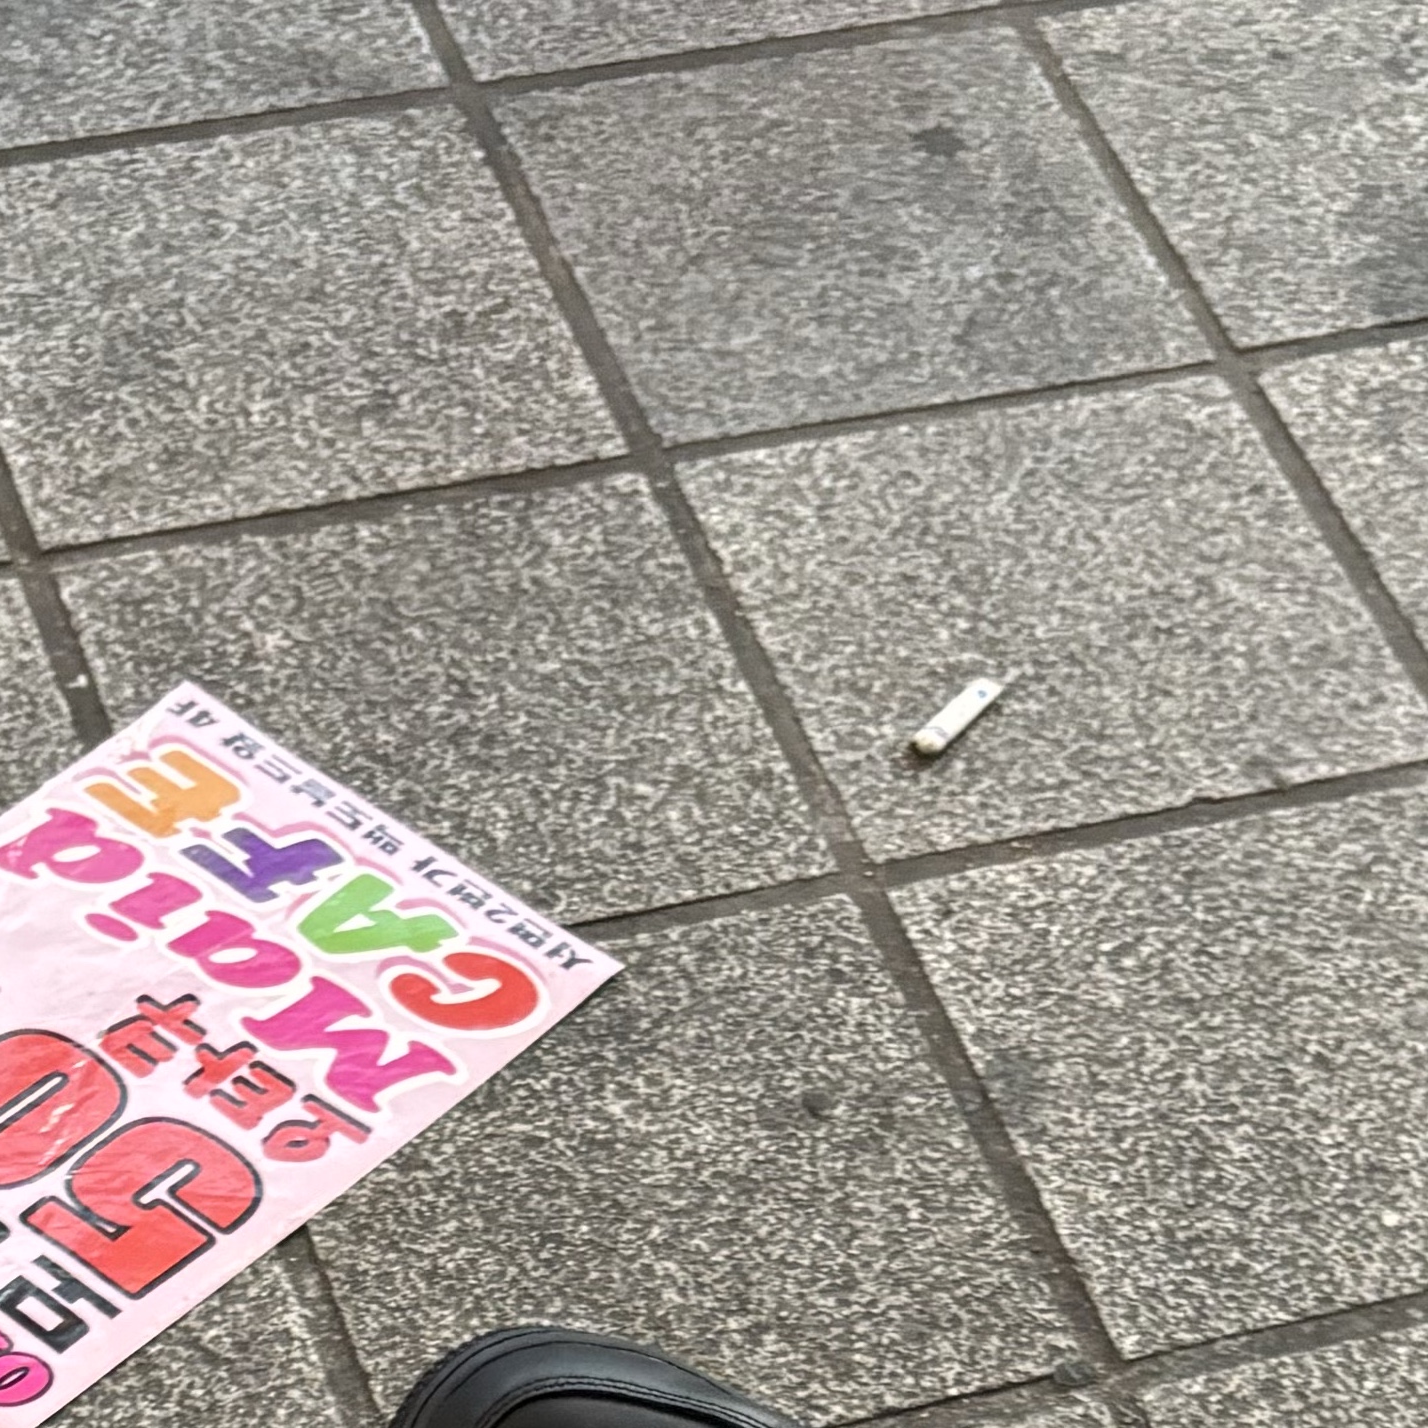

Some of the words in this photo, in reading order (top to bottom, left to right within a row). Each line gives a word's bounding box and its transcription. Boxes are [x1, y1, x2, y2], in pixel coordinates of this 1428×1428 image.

[167, 701, 220, 727] 4F
[86, 750, 539, 1029] CAFE
[411, 856, 593, 971] 서면2번가
[99, 993, 370, 1162] 오타쿠
